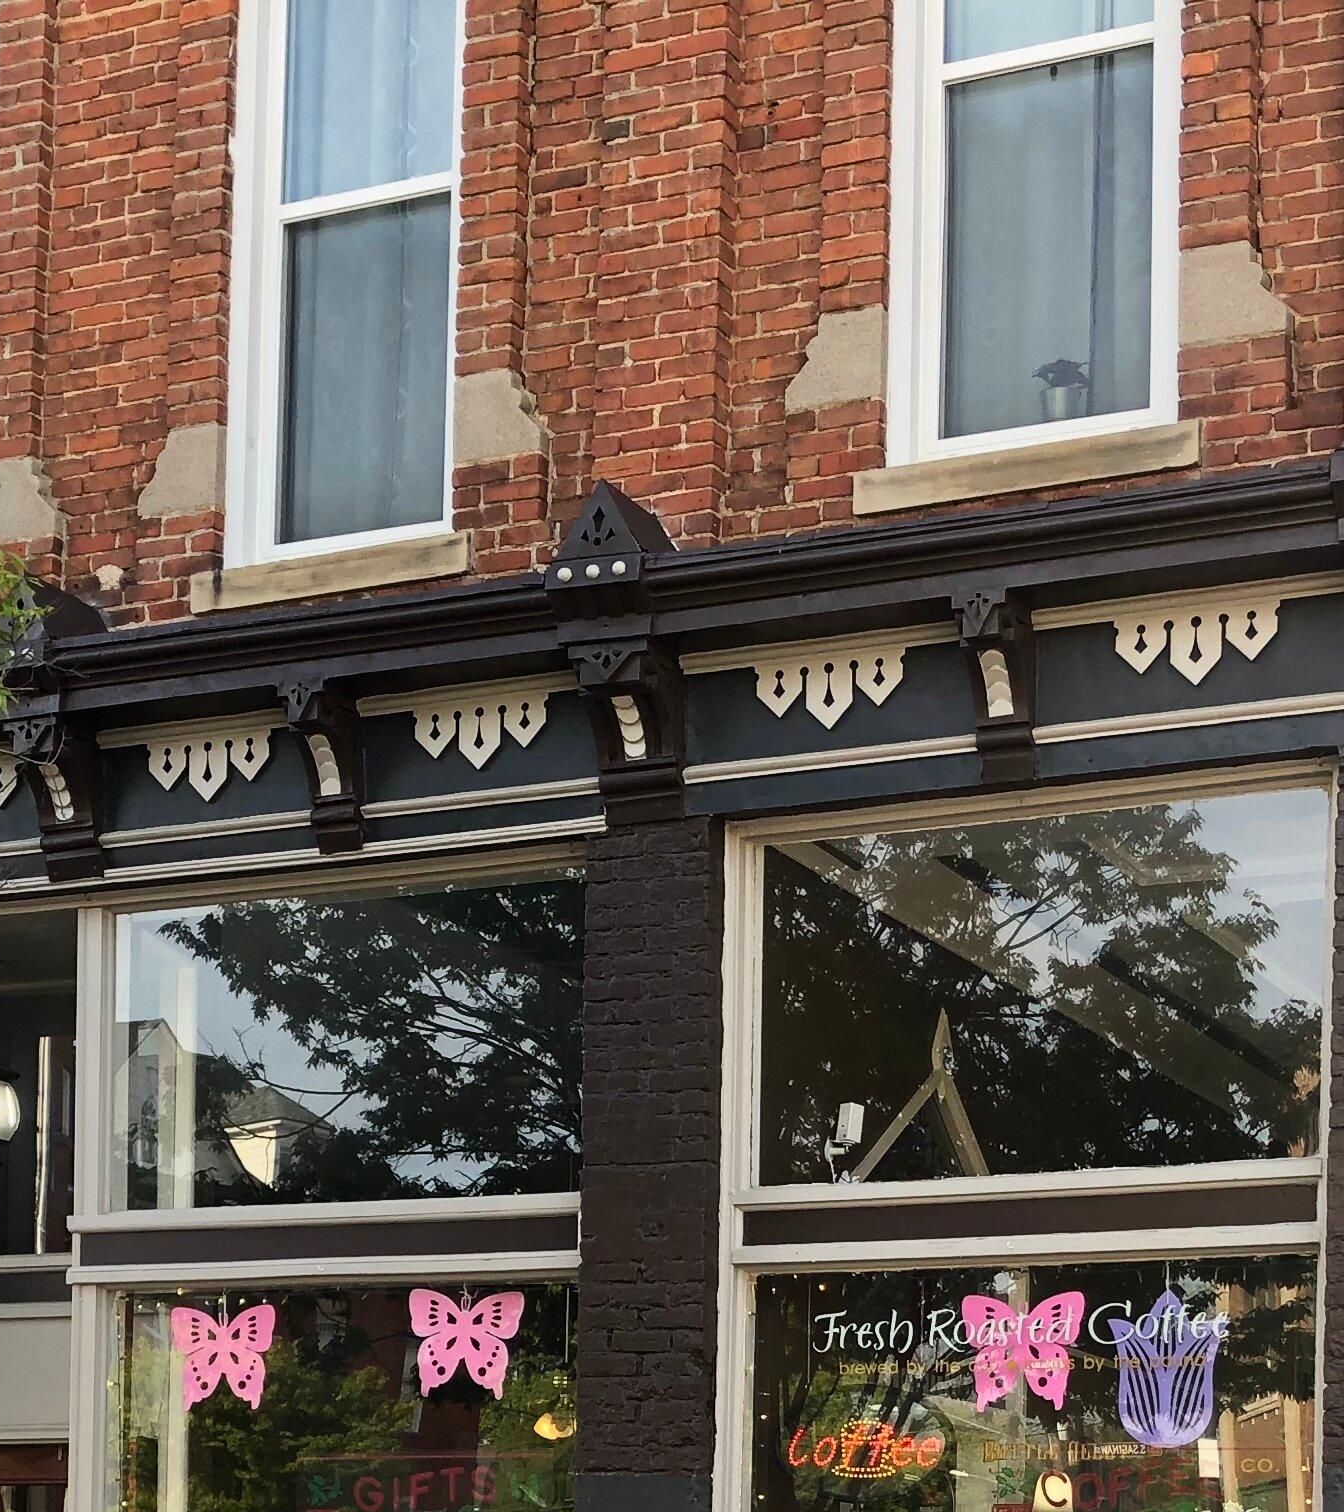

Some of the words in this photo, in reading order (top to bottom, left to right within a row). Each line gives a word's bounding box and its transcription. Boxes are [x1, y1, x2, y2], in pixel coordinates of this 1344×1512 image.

[812, 1308, 914, 1354] Fresh
[926, 1305, 1074, 1353] Roasted
[1088, 1299, 1231, 1346] Coffee
[839, 1360, 899, 1375] brewed
[906, 1360, 926, 1377] by
[1083, 1355, 1106, 1371] by
[353, 1466, 498, 1512] GIFTS
